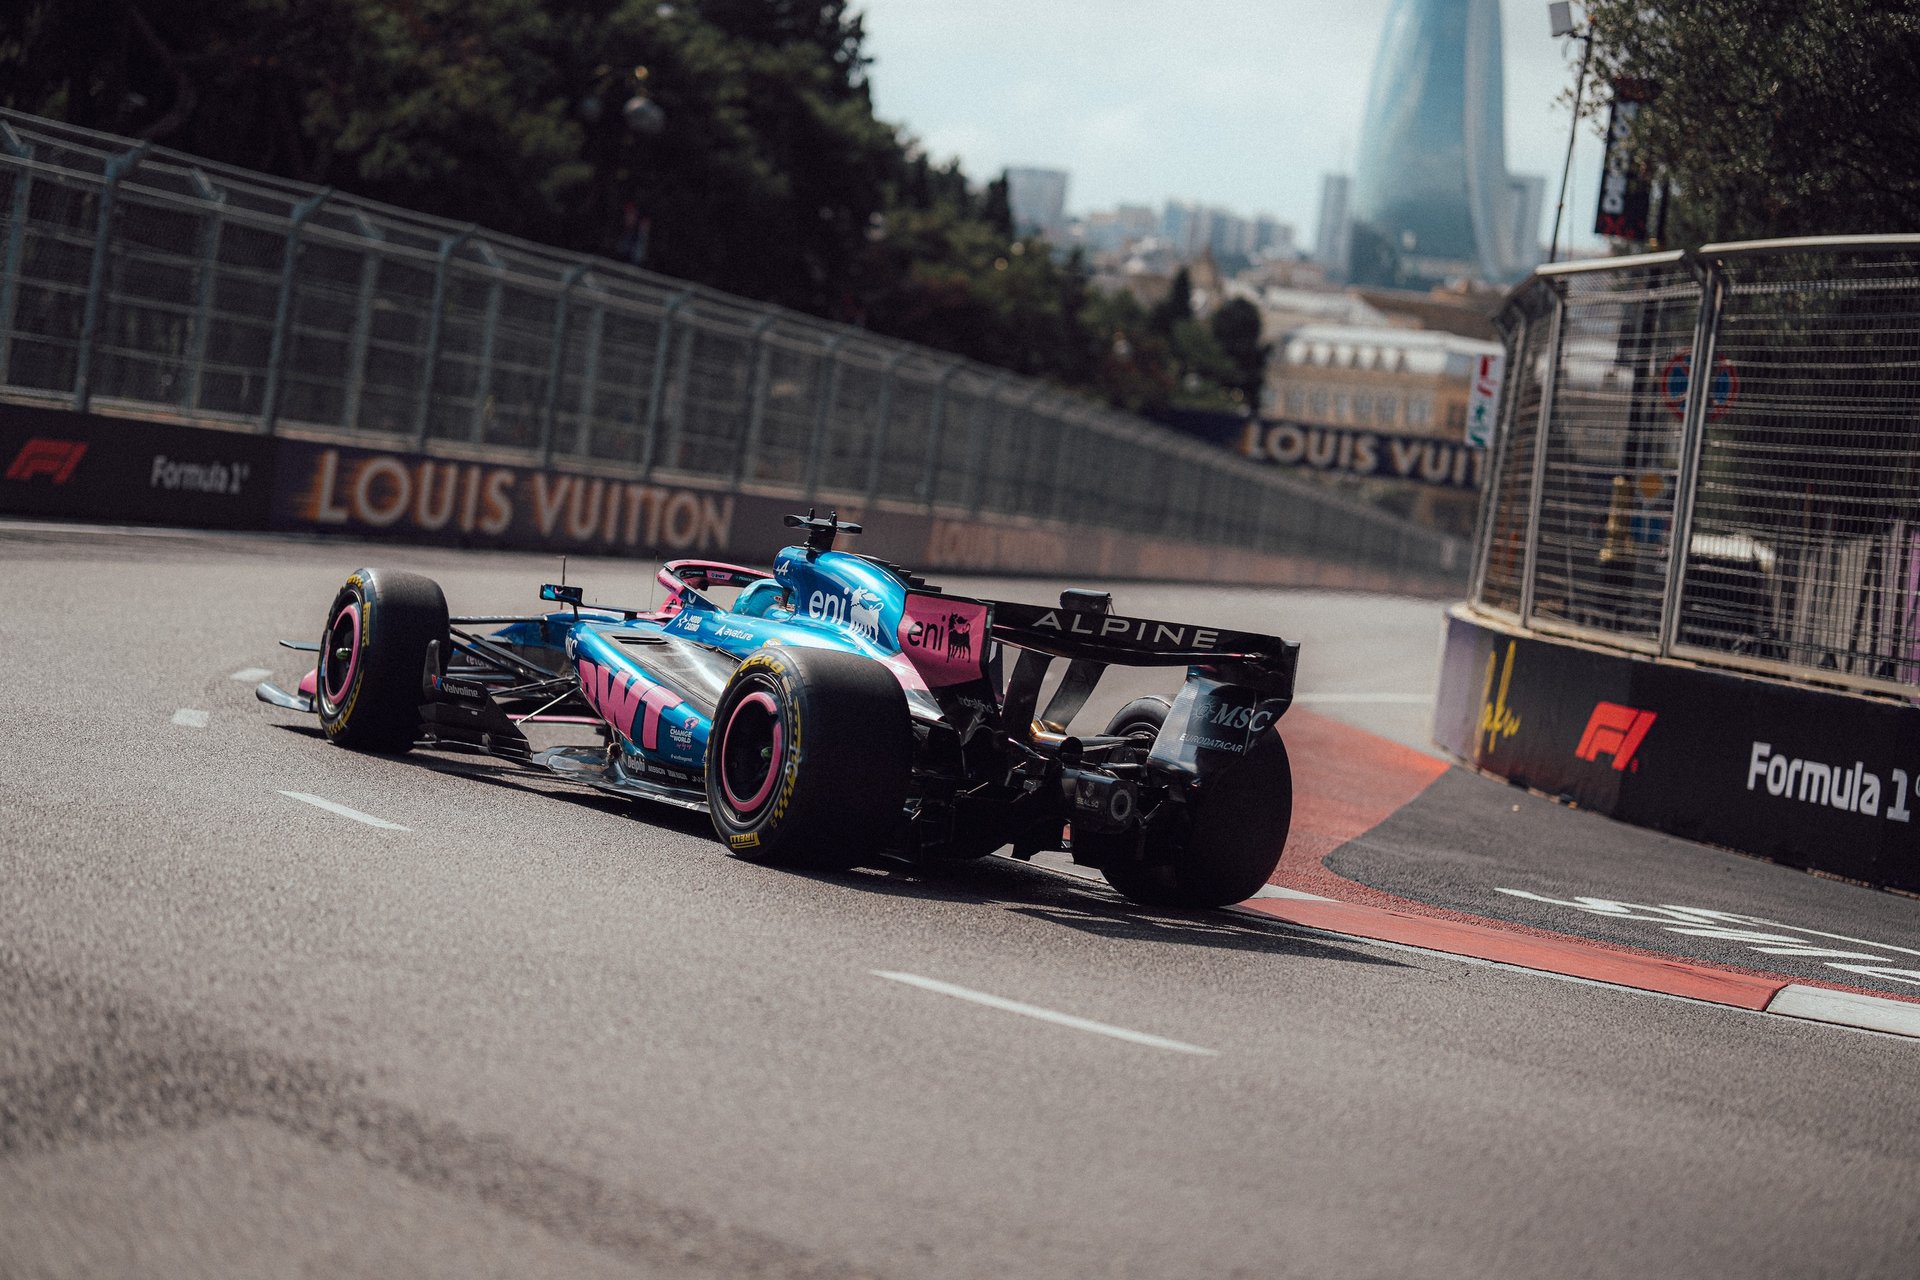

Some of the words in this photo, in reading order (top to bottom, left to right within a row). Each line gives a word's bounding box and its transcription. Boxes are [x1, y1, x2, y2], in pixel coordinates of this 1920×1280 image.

[1242, 422, 1378, 474] LOUIS
[151, 454, 229, 494] Formula
[308, 450, 515, 535] LOUIS
[532, 474, 735, 550] VUITTON
[808, 587, 850, 626] eni
[723, 628, 754, 641] avature
[907, 615, 946, 651] eni
[1032, 611, 1219, 649] ALPINE
[739, 653, 785, 674] ZERO
[442, 683, 479, 697] Valvoline
[1210, 703, 1273, 732] MSC
[669, 728, 692, 739] CHANGE
[1180, 732, 1243, 753] EURODATACAR
[627, 755, 646, 773] Delphi
[1746, 741, 1881, 817] Formula
[729, 831, 761, 849] PIRELLI
